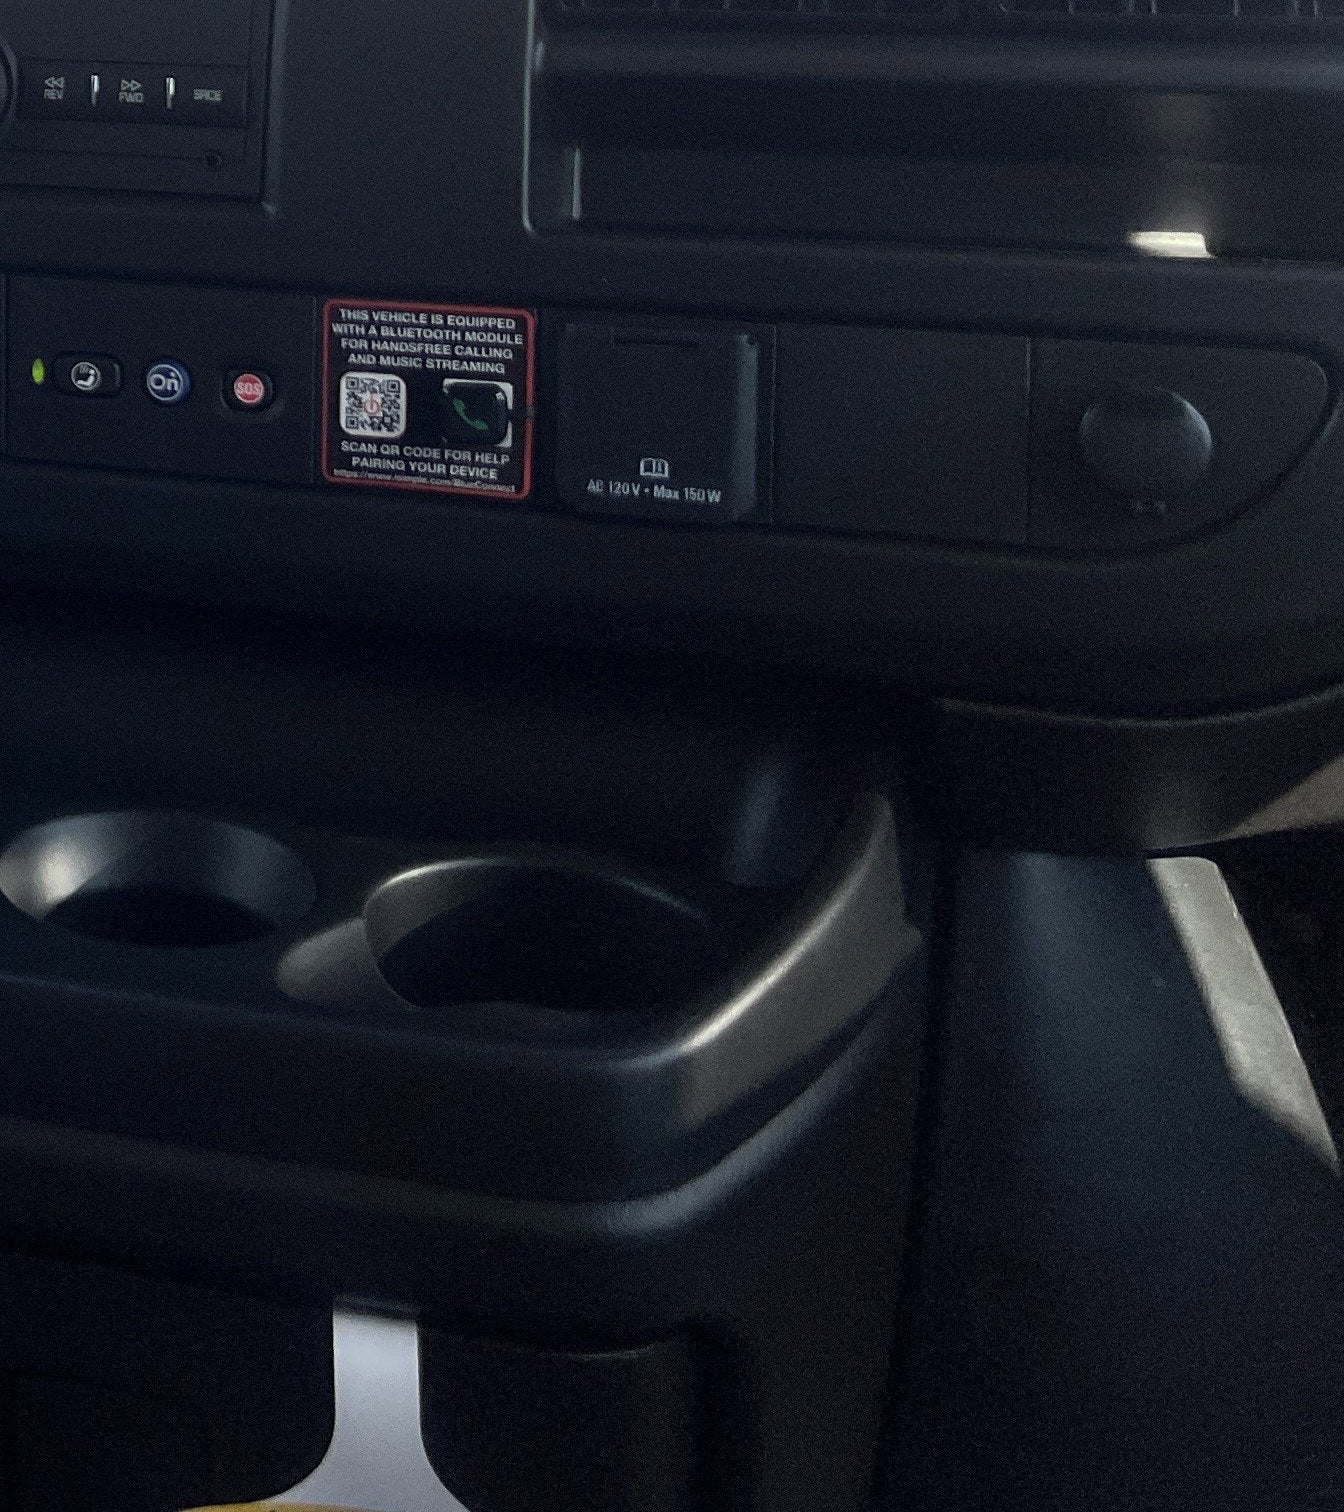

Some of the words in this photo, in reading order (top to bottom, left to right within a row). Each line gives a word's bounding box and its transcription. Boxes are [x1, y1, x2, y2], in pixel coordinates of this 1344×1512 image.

[43, 88, 64, 100] REV
[118, 92, 144, 103] FWD
[339, 308, 369, 321] THIS
[372, 310, 427, 324] VEHICLE
[431, 313, 443, 325] IS
[447, 315, 516, 329] EQUIPPED
[332, 323, 365, 336] WITH
[367, 325, 378, 336] A
[380, 325, 461, 341] BLUETOOTH
[464, 331, 523, 345] MODULE
[341, 338, 368, 350] FOR
[371, 339, 451, 355] HANDSFREE
[454, 345, 513, 359] CALLING
[348, 353, 376, 365] AND
[378, 355, 422, 368] MUSIC
[426, 359, 505, 374] STREAMING
[236, 381, 262, 395] SOS
[340, 440, 378, 454] SCAN
[380, 444, 400, 456] QR
[403, 446, 441, 460] CODE
[444, 449, 471, 461] FOR
[474, 452, 510, 465] HELP
[351, 456, 406, 471] PAIRING
[408, 460, 446, 474] YOUR
[449, 464, 498, 480] DEVICE
[587, 478, 604, 493] AC
[653, 484, 680, 500] Max
